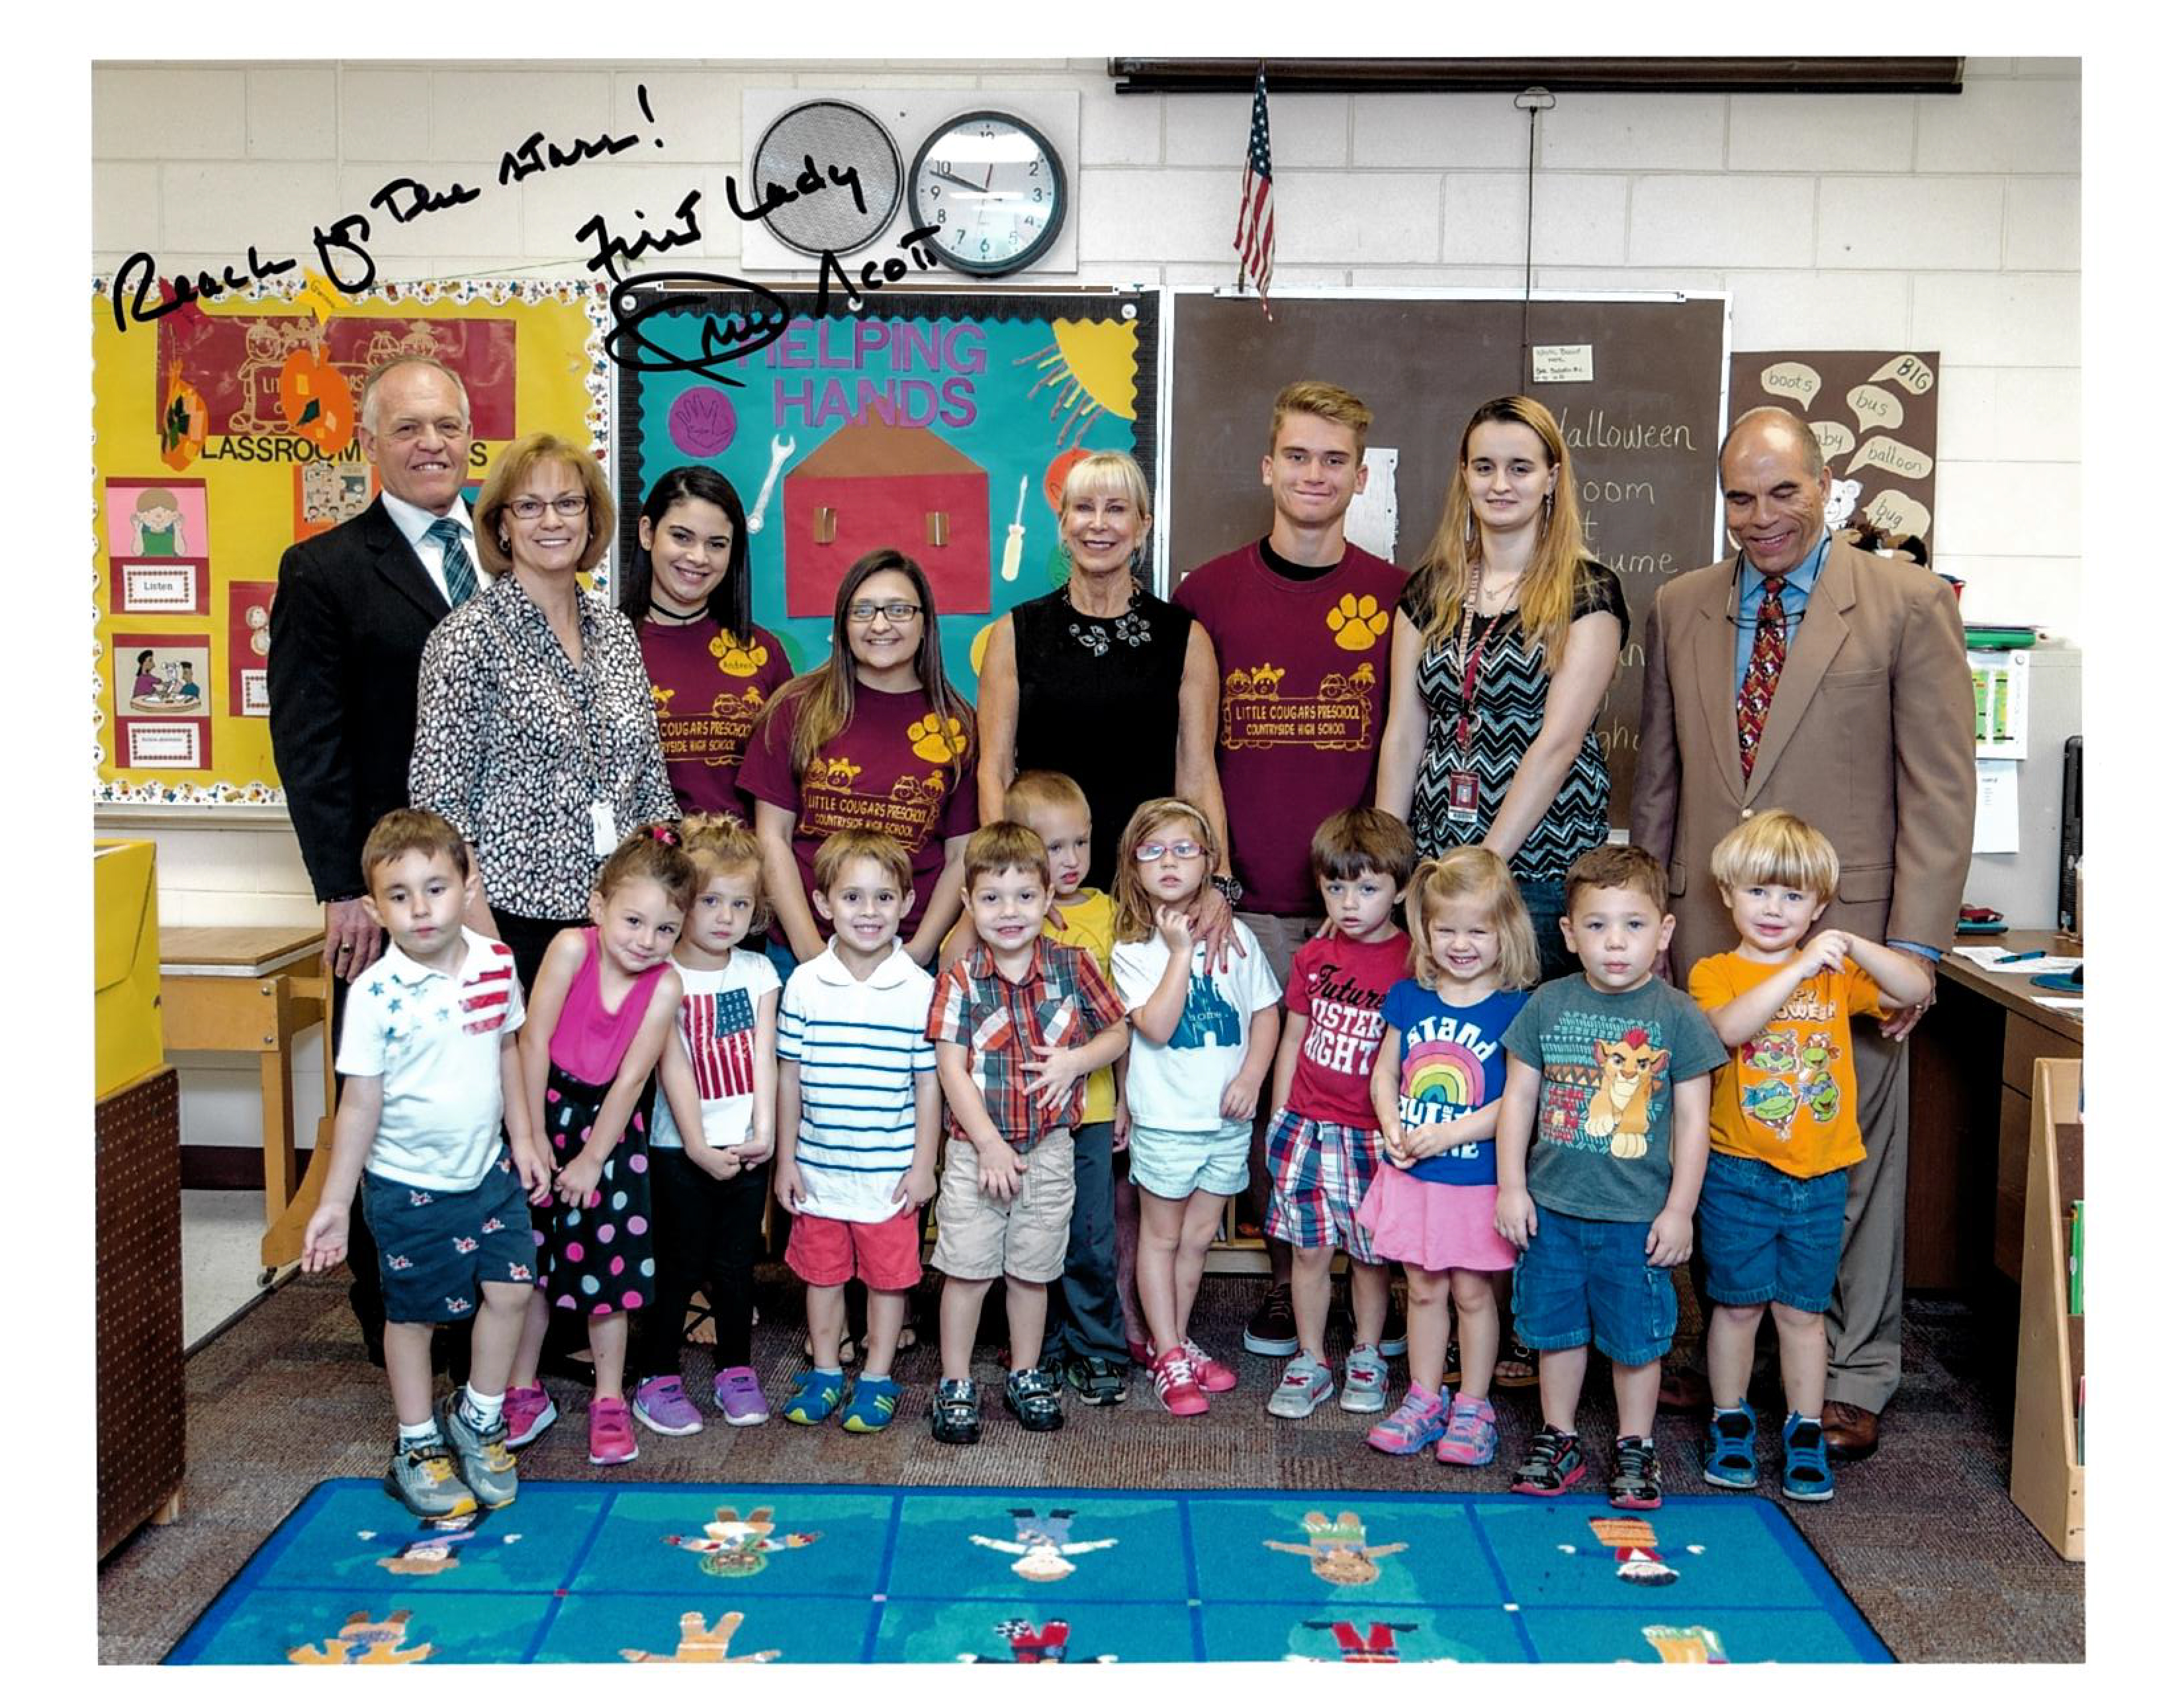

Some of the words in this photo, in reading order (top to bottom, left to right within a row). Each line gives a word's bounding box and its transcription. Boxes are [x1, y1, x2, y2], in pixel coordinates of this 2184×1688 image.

[936, 161, 951, 175] 10
[1029, 161, 1039, 176] 2
[930, 185, 940, 200] 9
[1032, 187, 1042, 203] 3
[576, 190, 702, 283] First
[726, 154, 868, 220] Lady
[937, 209, 946, 224] 8
[1024, 214, 1034, 226] 4
[957, 228, 966, 244] 7
[1009, 230, 1017, 245] 5
[979, 238, 989, 252] 6
[113, 248, 296, 332] Reach
[738, 319, 987, 375] HELPING
[1768, 371, 1813, 393] boots
[1896, 357, 1931, 391] BIG
[773, 376, 977, 428] HANDS
[1856, 389, 1888, 417] bus
[1868, 442, 1921, 473] balloon
[1876, 496, 1903, 530] bug
[144, 581, 173, 591] Listen
[1235, 706, 1267, 720] LITTLE
[1270, 705, 1316, 720] COUGARS
[1318, 705, 1360, 720] PRESCHOOL
[660, 721, 708, 737] COUGARS
[1246, 722, 1295, 735] COUNTRYSIDE
[1298, 723, 1316, 735] HIGH
[1318, 722, 1345, 735] SCHOOL
[709, 739, 736, 752] SCHOOL
[807, 794, 836, 812] LITTLE
[839, 798, 885, 818] COUGARS
[815, 813, 863, 828] COUNTRYSIDE
[885, 822, 913, 837] SCHOOL
[1310, 964, 1386, 1009] Future
